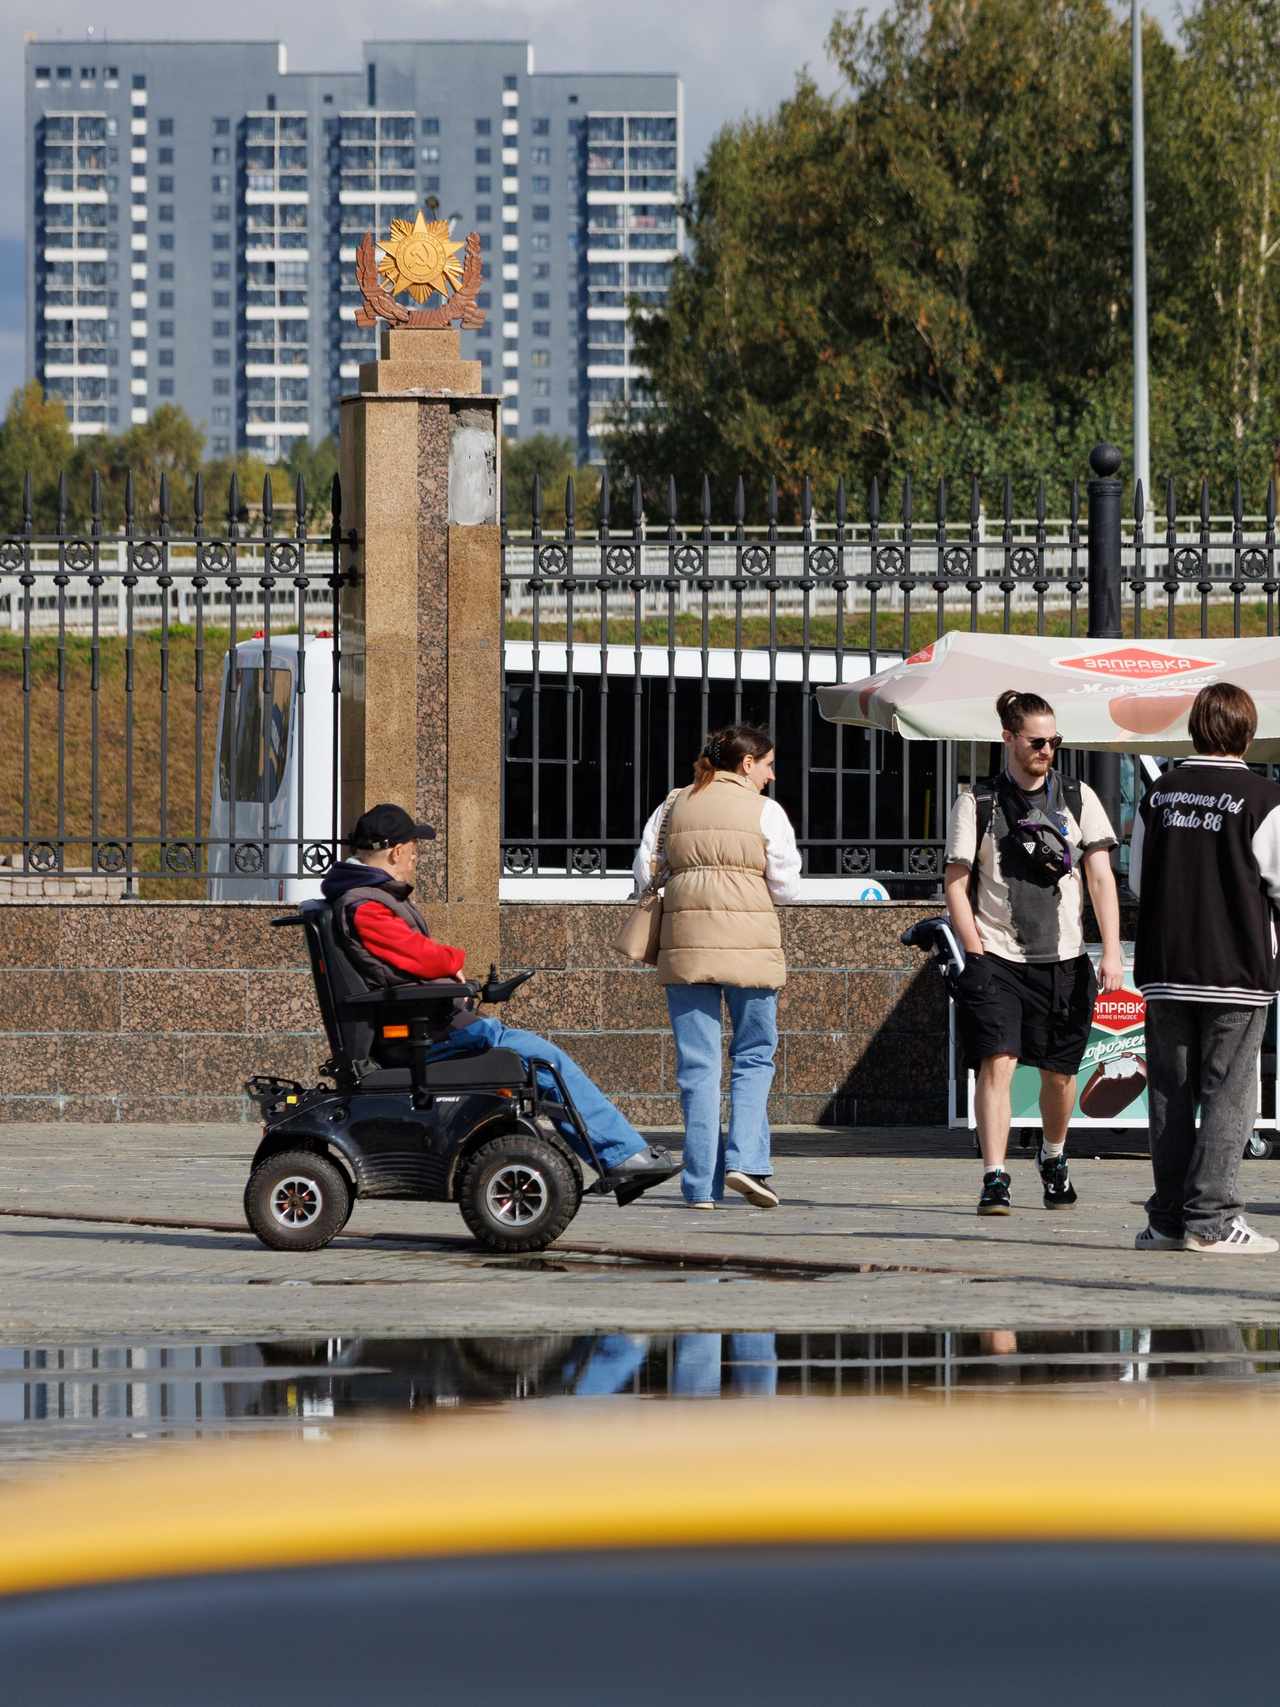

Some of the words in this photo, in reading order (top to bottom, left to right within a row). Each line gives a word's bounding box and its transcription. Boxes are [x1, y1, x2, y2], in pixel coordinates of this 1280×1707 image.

[1083, 658, 1192, 669] ЗАПРАВКА
[1067, 674, 1219, 694] Мороженое
[1150, 791, 1217, 808] Campeones
[1217, 793, 1245, 814] Del
[1162, 809, 1202, 828] Estado
[1202, 812, 1223, 832] 86
[1094, 1002, 1146, 1013] АПРАВК
